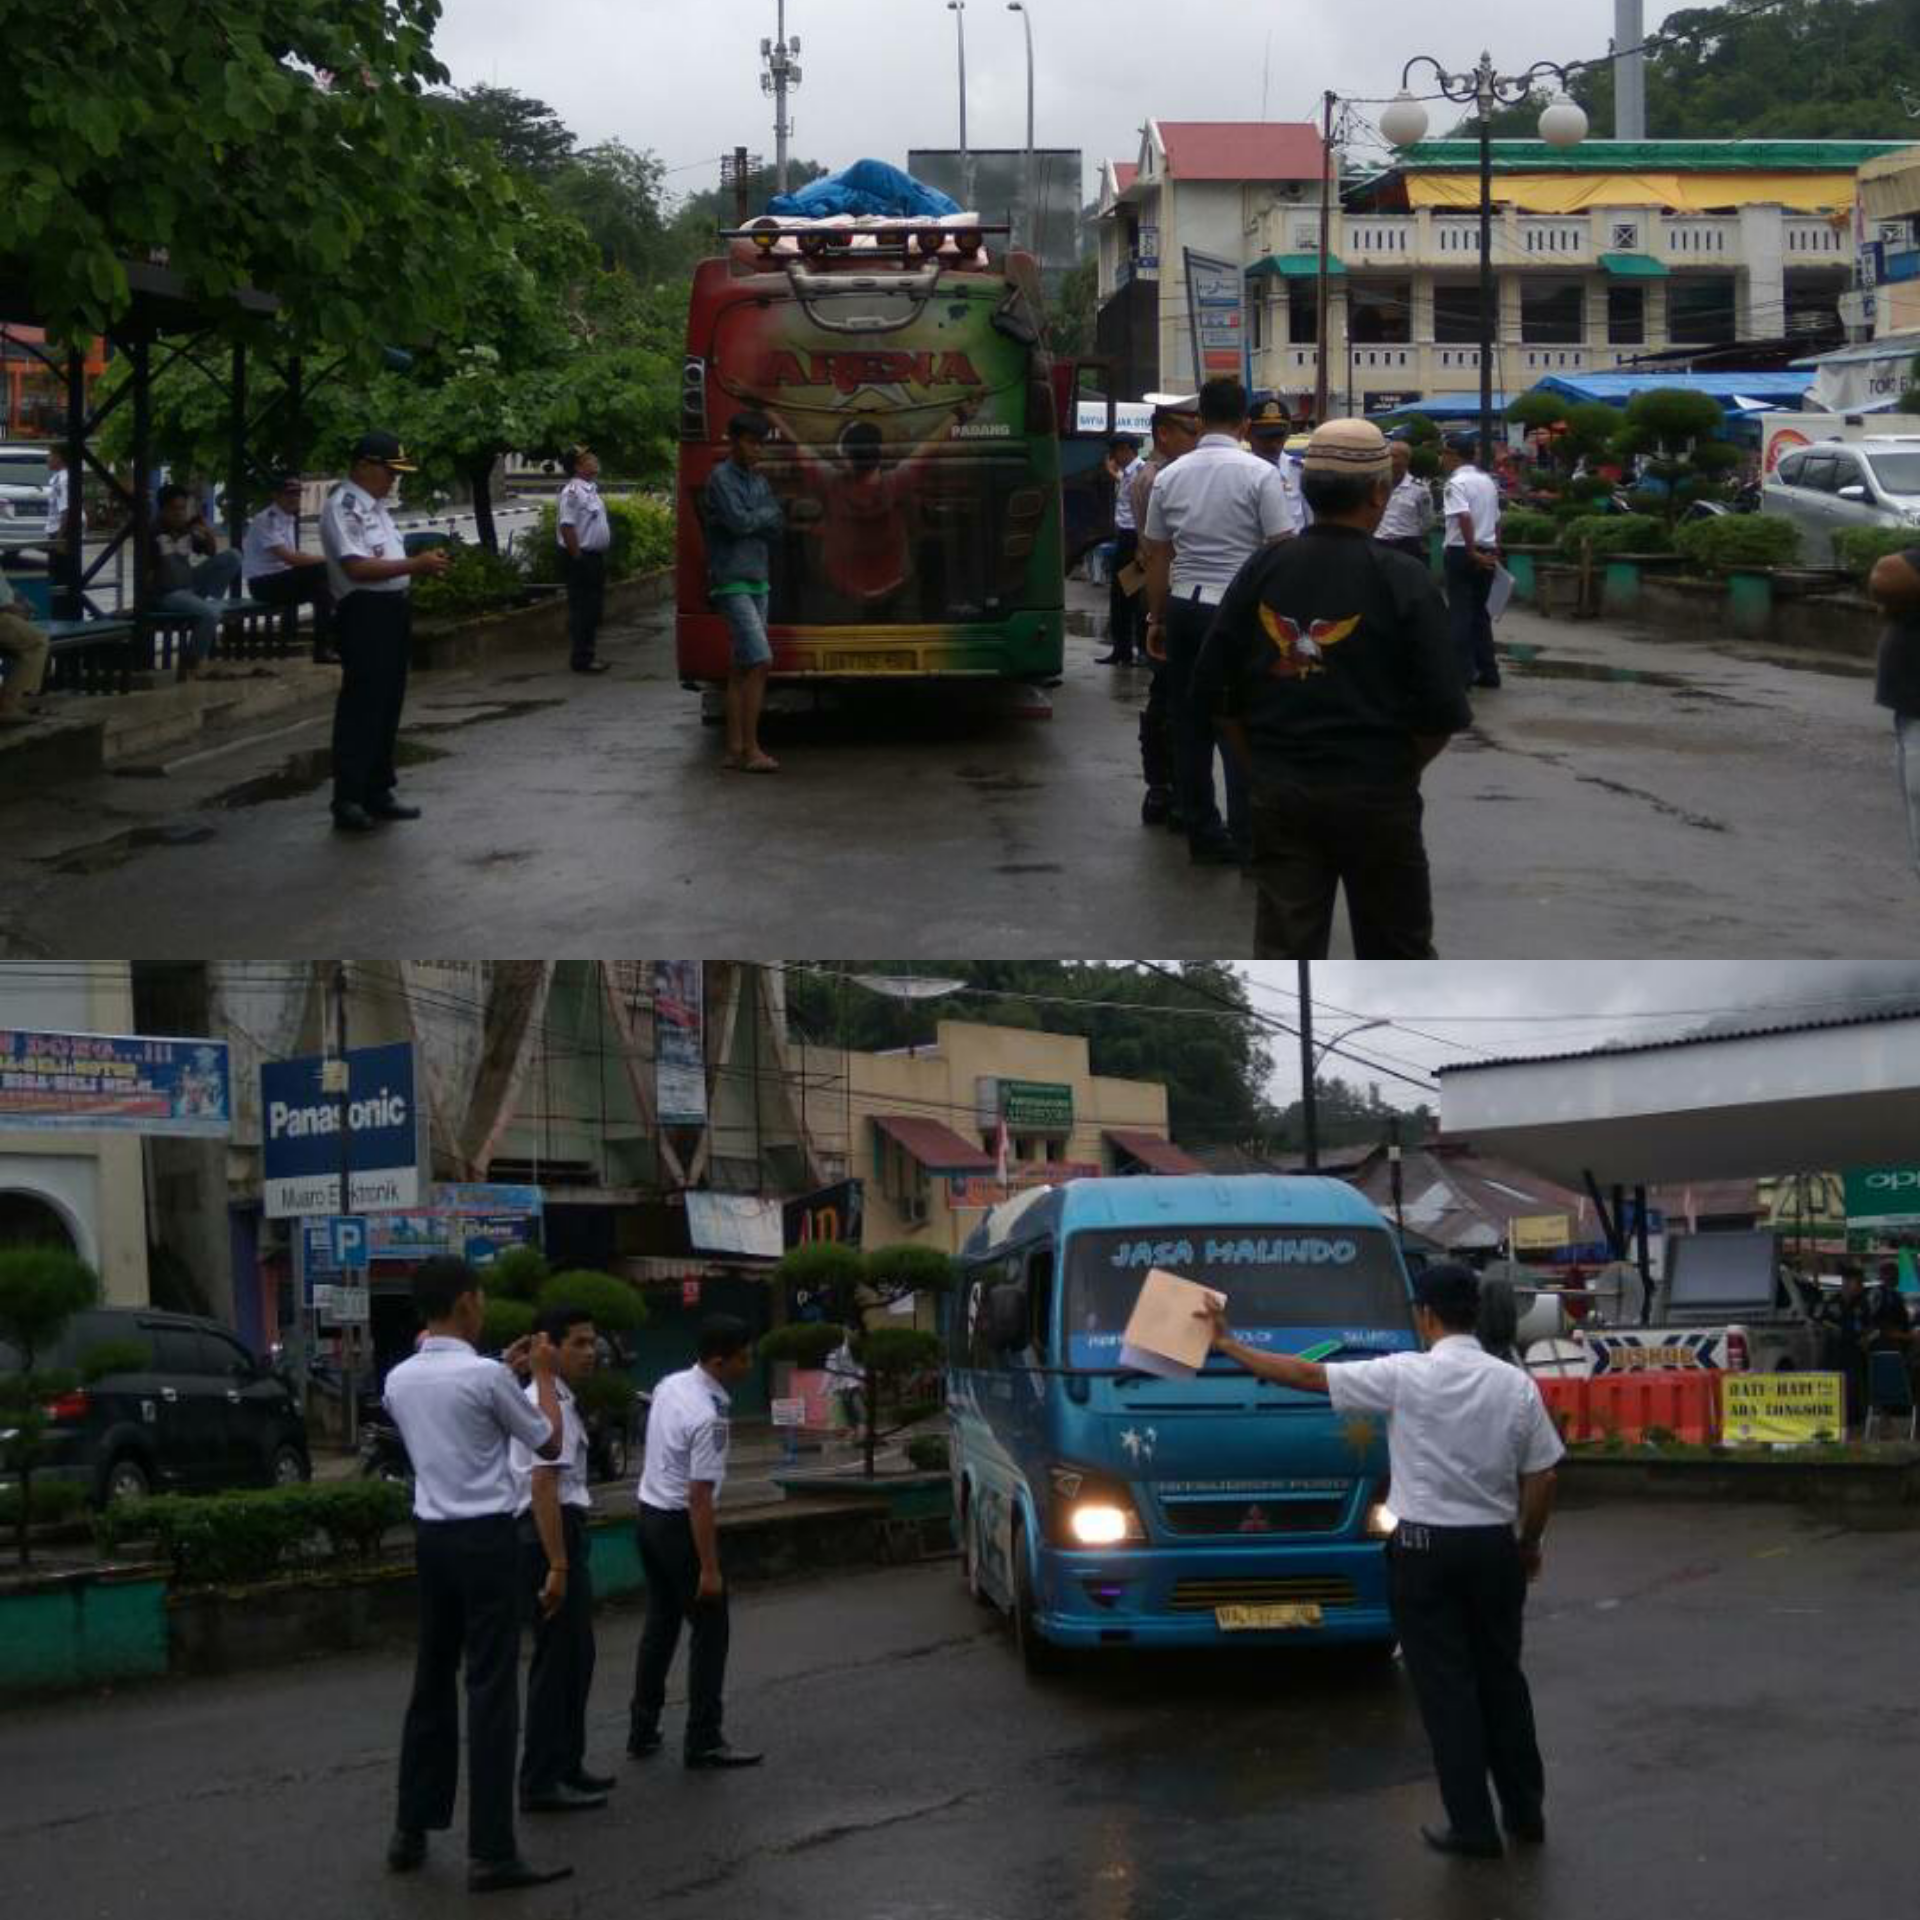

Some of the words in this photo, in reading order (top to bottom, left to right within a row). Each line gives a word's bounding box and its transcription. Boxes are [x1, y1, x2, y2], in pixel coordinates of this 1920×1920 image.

[769, 350, 982, 394] ARENA
[951, 424, 1011, 437] PADANG
[270, 1086, 406, 1140] Panasonic
[328, 1178, 400, 1206] Ektronik
[335, 1224, 361, 1262] P
[1111, 1239, 1194, 1268] JASA
[1204, 1238, 1357, 1265] MALINDO
